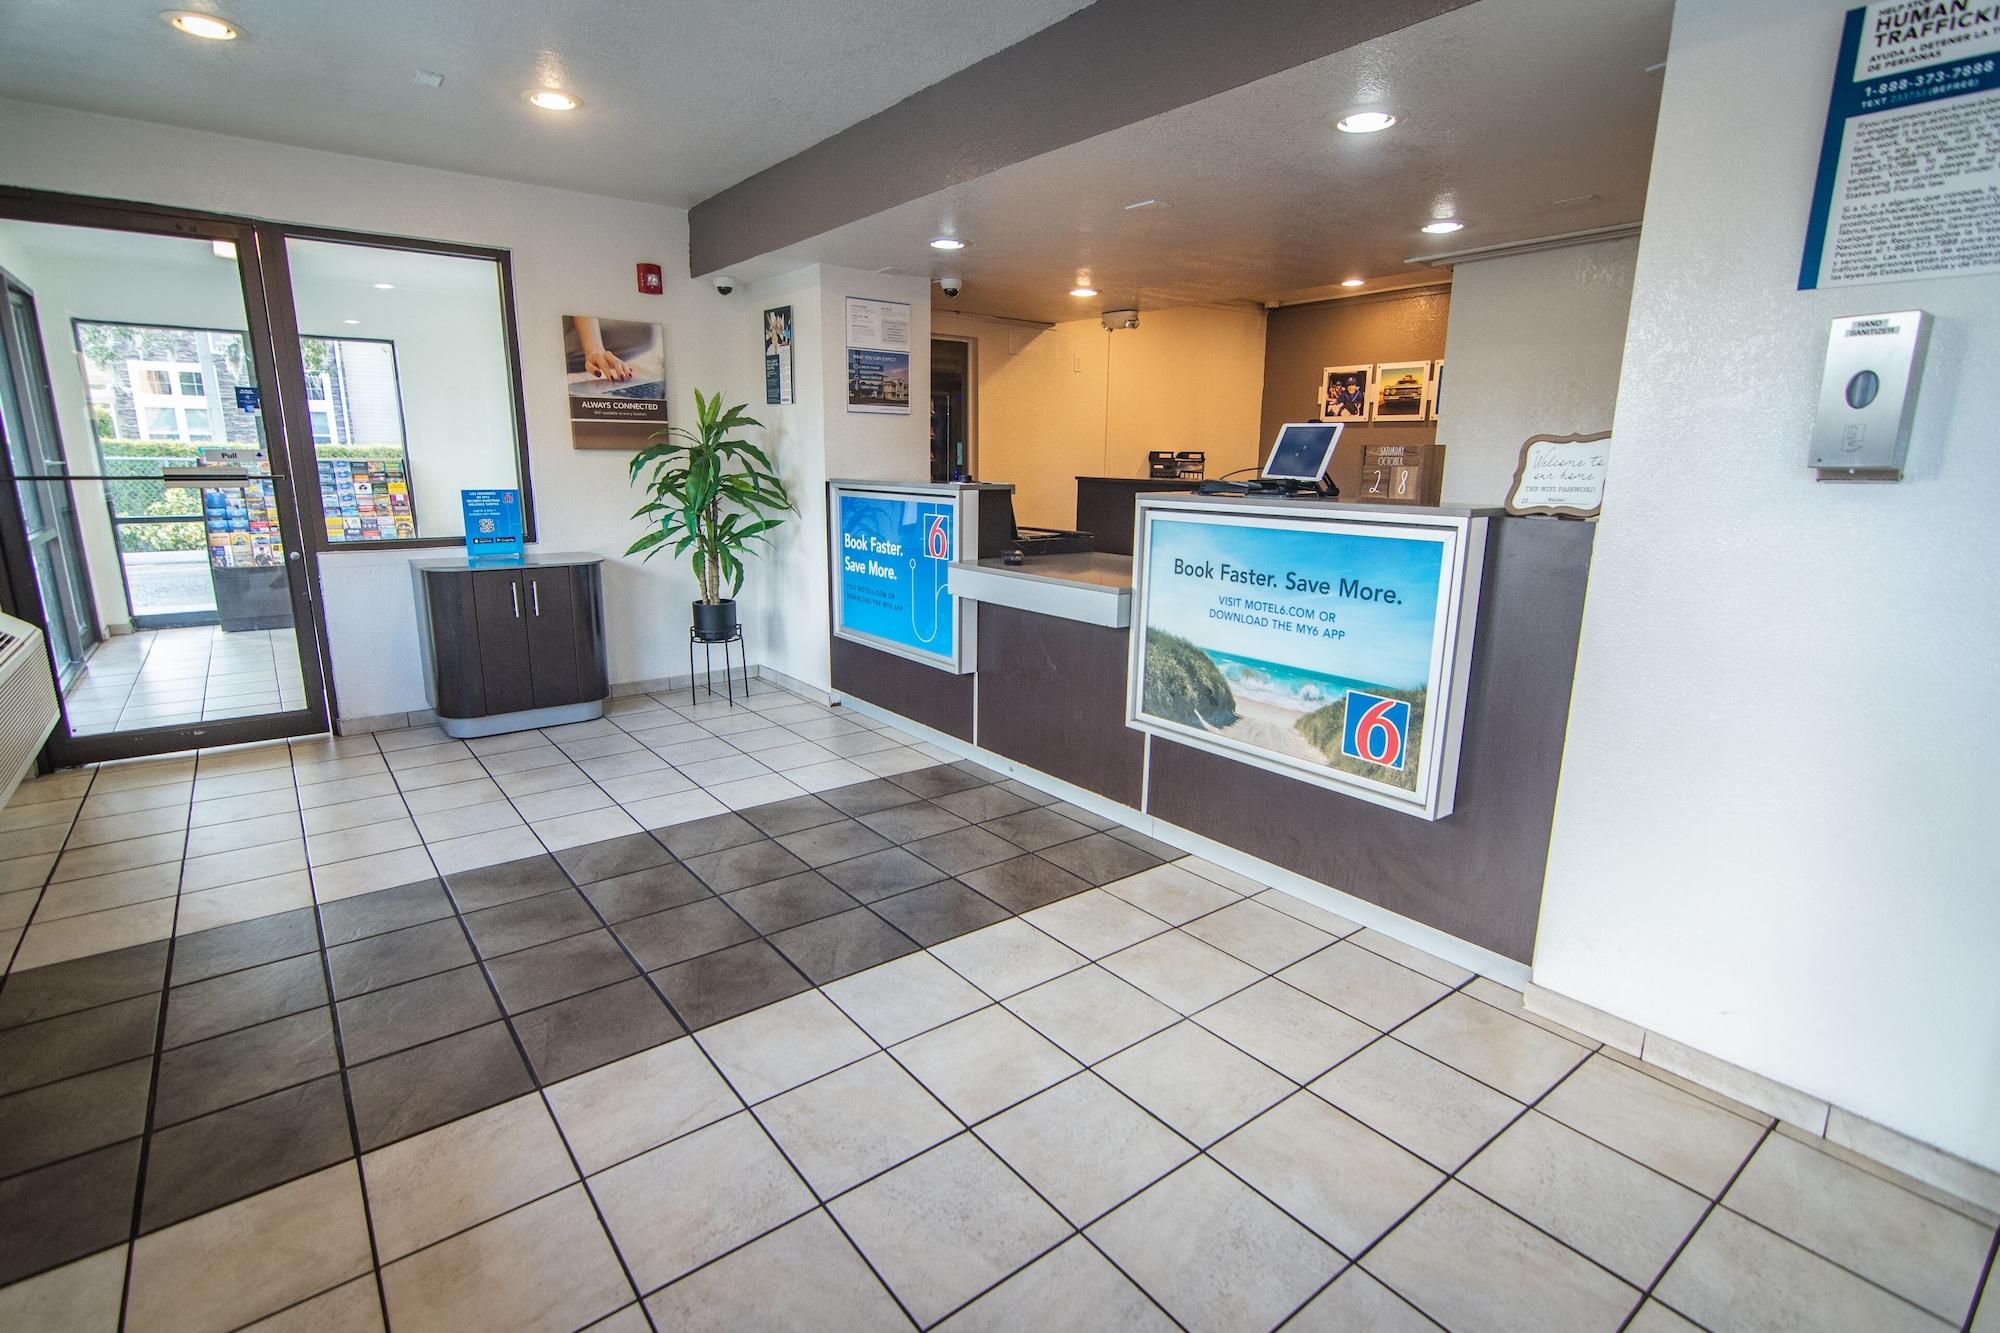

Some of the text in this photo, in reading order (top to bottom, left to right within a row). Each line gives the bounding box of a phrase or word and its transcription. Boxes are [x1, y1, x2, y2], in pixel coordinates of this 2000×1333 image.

[1876, 0, 1968, 32] HUMAN
[1870, 50, 1904, 62] AYUDA
[1920, 34, 1971, 50] DETENER
[1974, 29, 1989, 38] LA
[1868, 51, 1941, 72] DE PERSONAS
[1864, 60, 1995, 97] 1-888-373-7888
[1862, 96, 1888, 108] TEXT
[1850, 327, 1895, 336] SANITIZER
[1378, 457, 1403, 466] OCTOBER
[1380, 446, 1405, 456] SATURDAY
[1534, 446, 1606, 468] Welcome to
[1369, 470, 1408, 494] 2 8
[844, 533, 903, 556] Book Faster.
[929, 515, 947, 558] 6
[845, 556, 897, 580] Save More.
[858, 585, 887, 599] MOTEL6.COM
[1174, 558, 1402, 605] Book Faster. Save More.
[846, 593, 872, 605] DOWNLOAD
[872, 598, 881, 607] THE
[894, 603, 903, 611] APP
[1219, 596, 1336, 623] VISIT MOTEL6.COM OR
[1209, 609, 1345, 641] DOWNLOAD THE MY6 APP
[1355, 699, 1401, 767] 6
